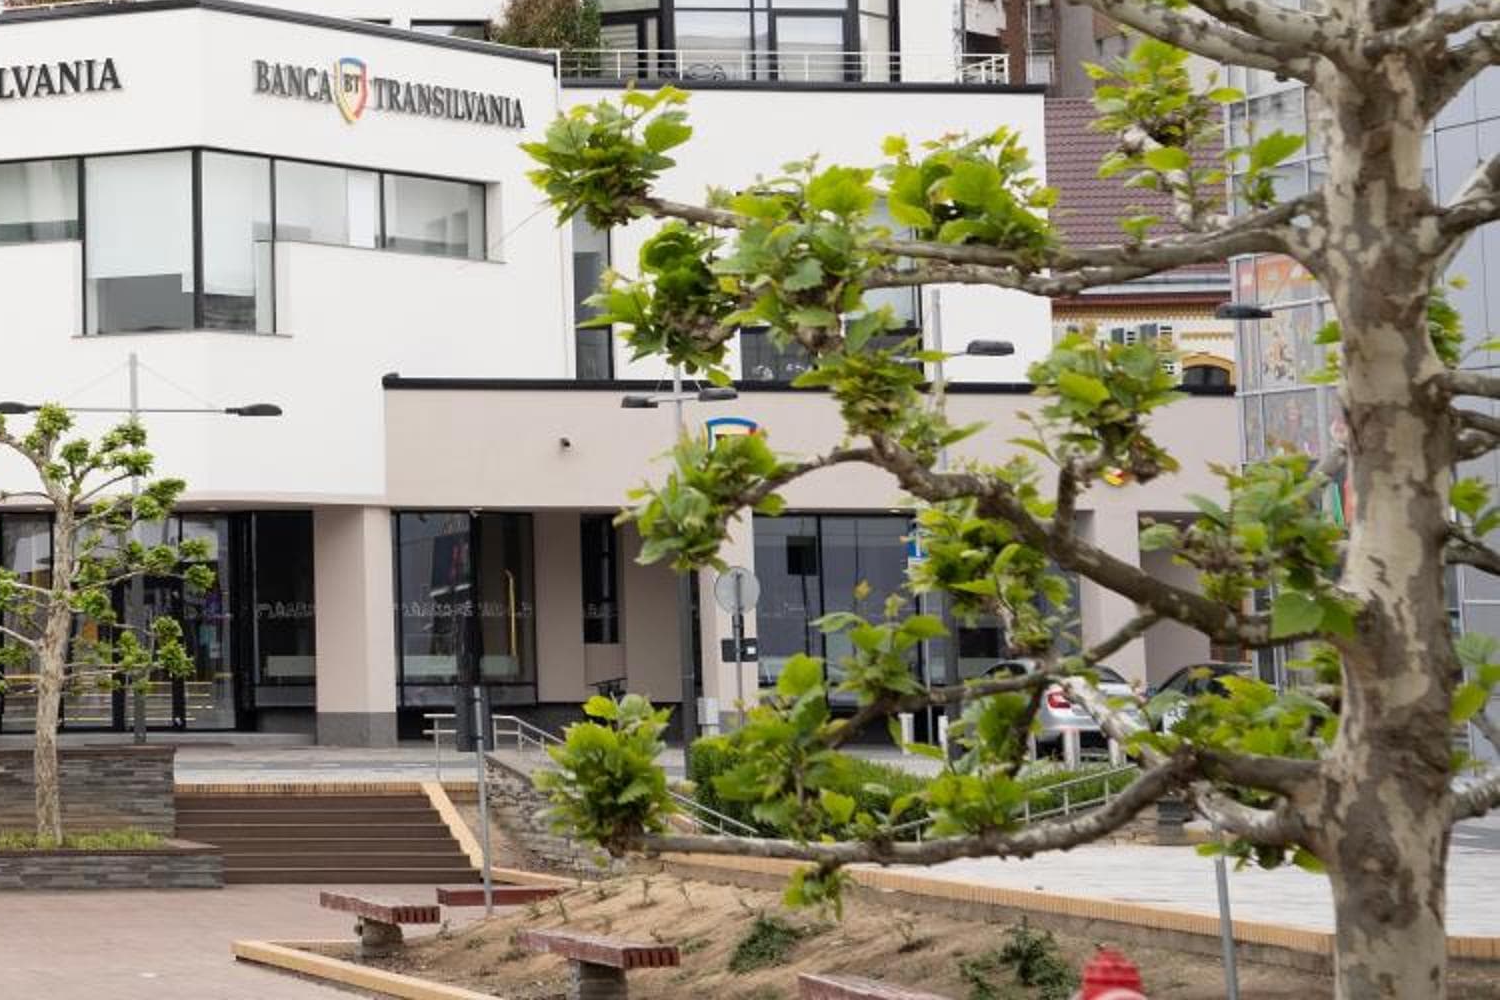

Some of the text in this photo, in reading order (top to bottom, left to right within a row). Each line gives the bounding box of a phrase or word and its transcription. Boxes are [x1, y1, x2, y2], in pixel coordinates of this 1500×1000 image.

[255, 60, 525, 129] BANCA BT TRANSILVANIA
